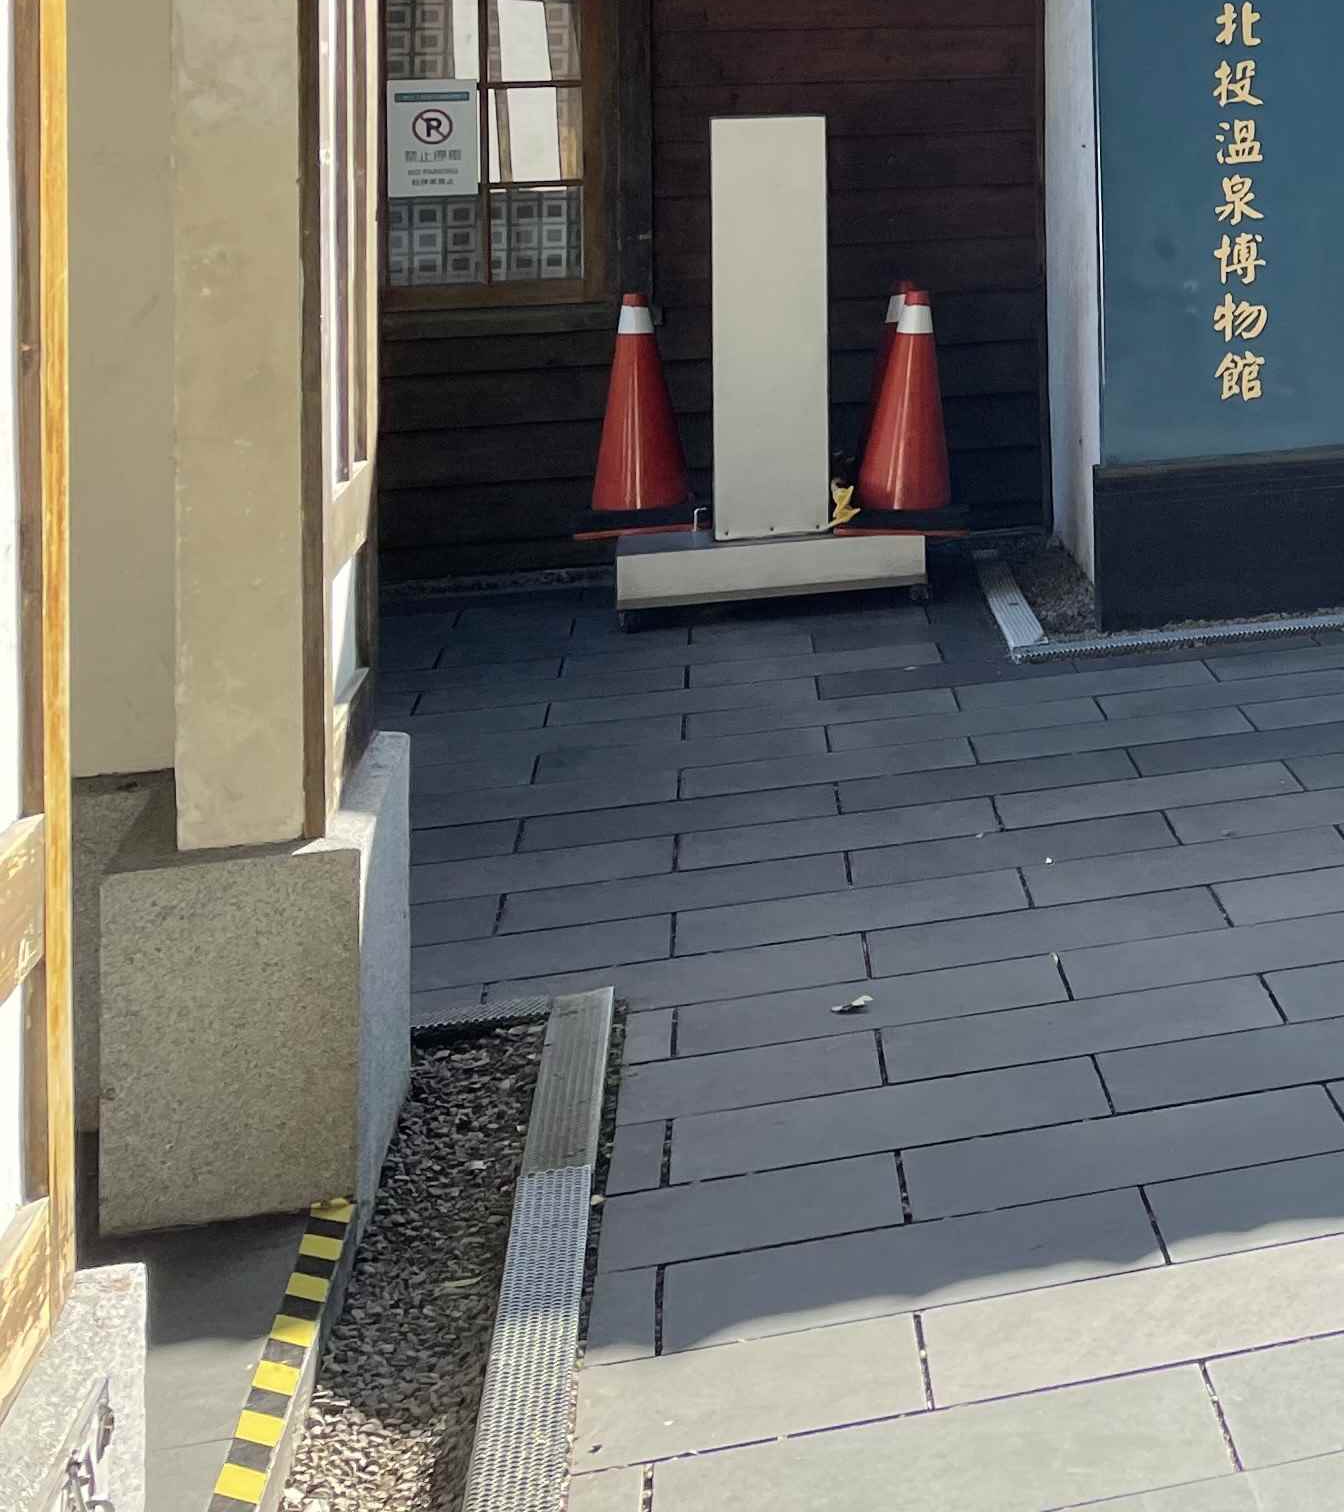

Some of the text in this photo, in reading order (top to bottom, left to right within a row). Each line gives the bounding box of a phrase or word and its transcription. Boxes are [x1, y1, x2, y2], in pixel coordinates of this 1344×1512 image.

[1213, 1, 1268, 402] 北投溫泉博物館
